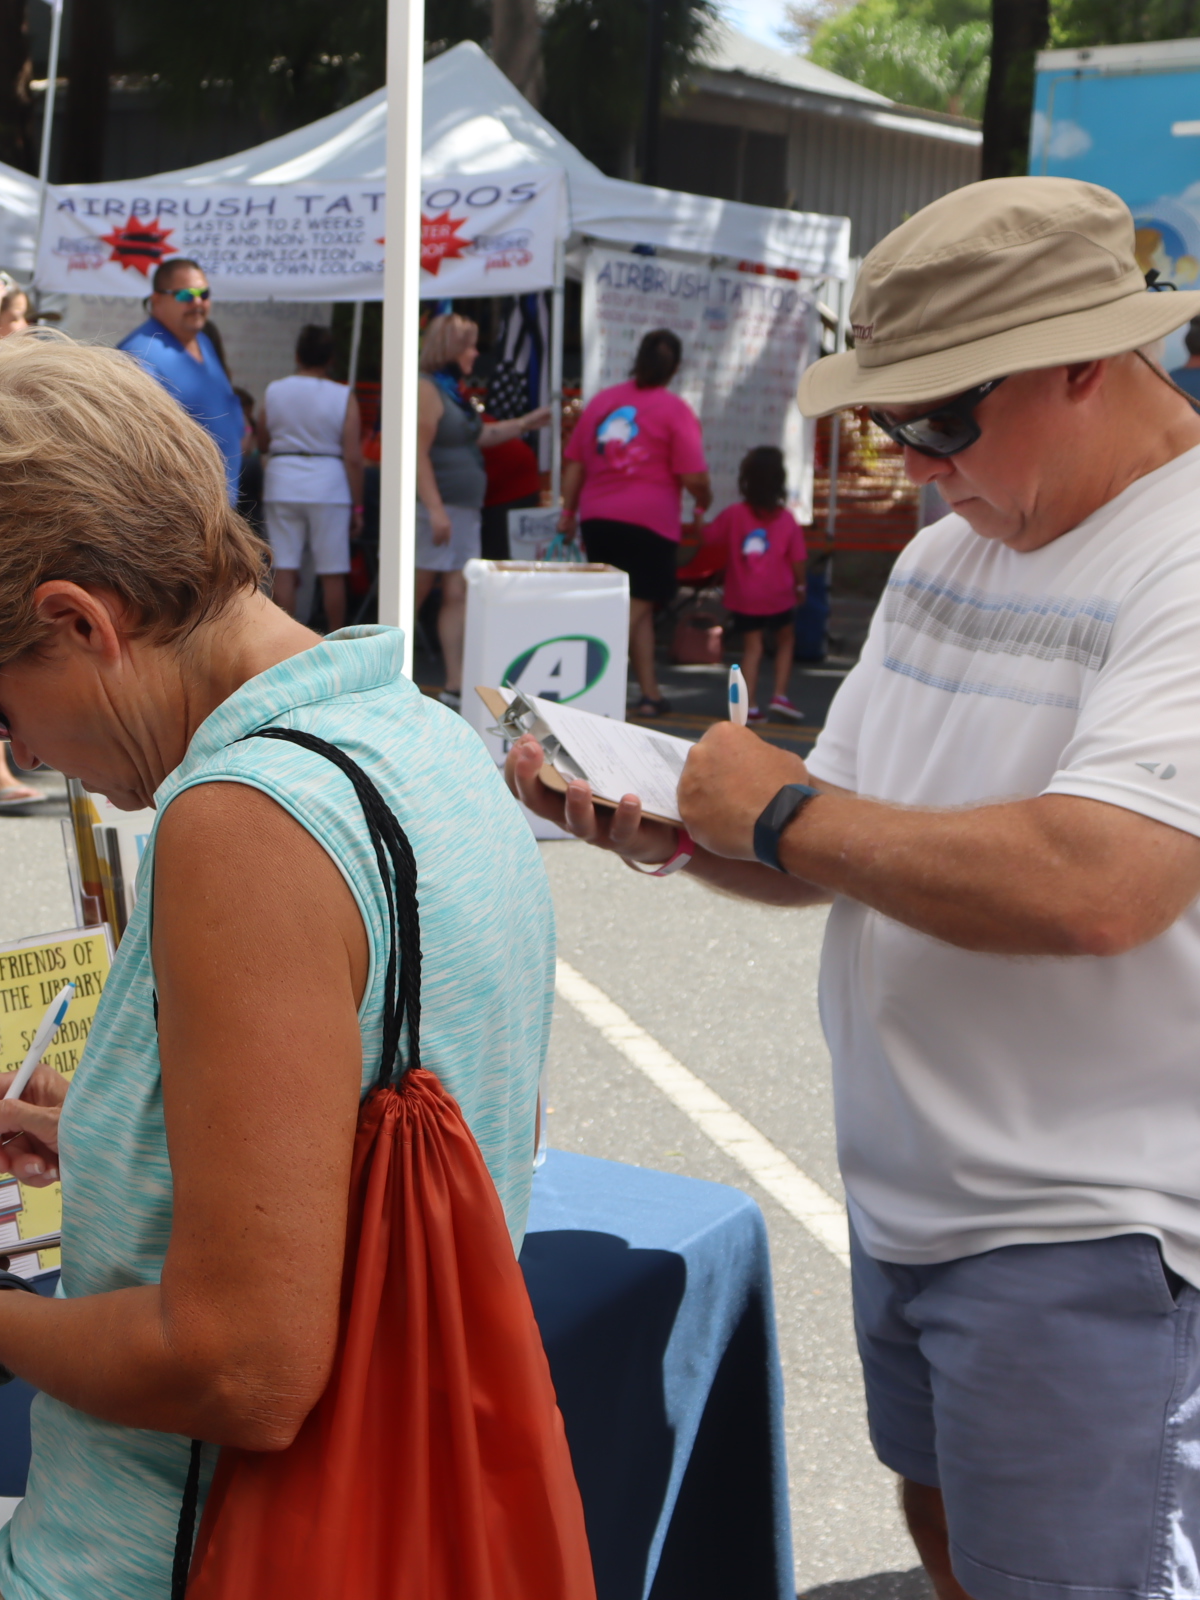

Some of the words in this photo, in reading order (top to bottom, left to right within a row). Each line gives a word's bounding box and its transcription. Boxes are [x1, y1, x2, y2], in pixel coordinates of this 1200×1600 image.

[56, 196, 277, 217] AIRBRUSH
[294, 183, 538, 214] TATOOS
[265, 218, 286, 231] TO
[307, 217, 365, 231] WEEKS
[183, 234, 220, 247] SAFE
[226, 233, 261, 247] AND
[244, 248, 357, 264] APPLICATION
[272, 261, 315, 275] OWN
[596, 260, 711, 300] AIRBRUSH
[73, 941, 94, 966] OF
